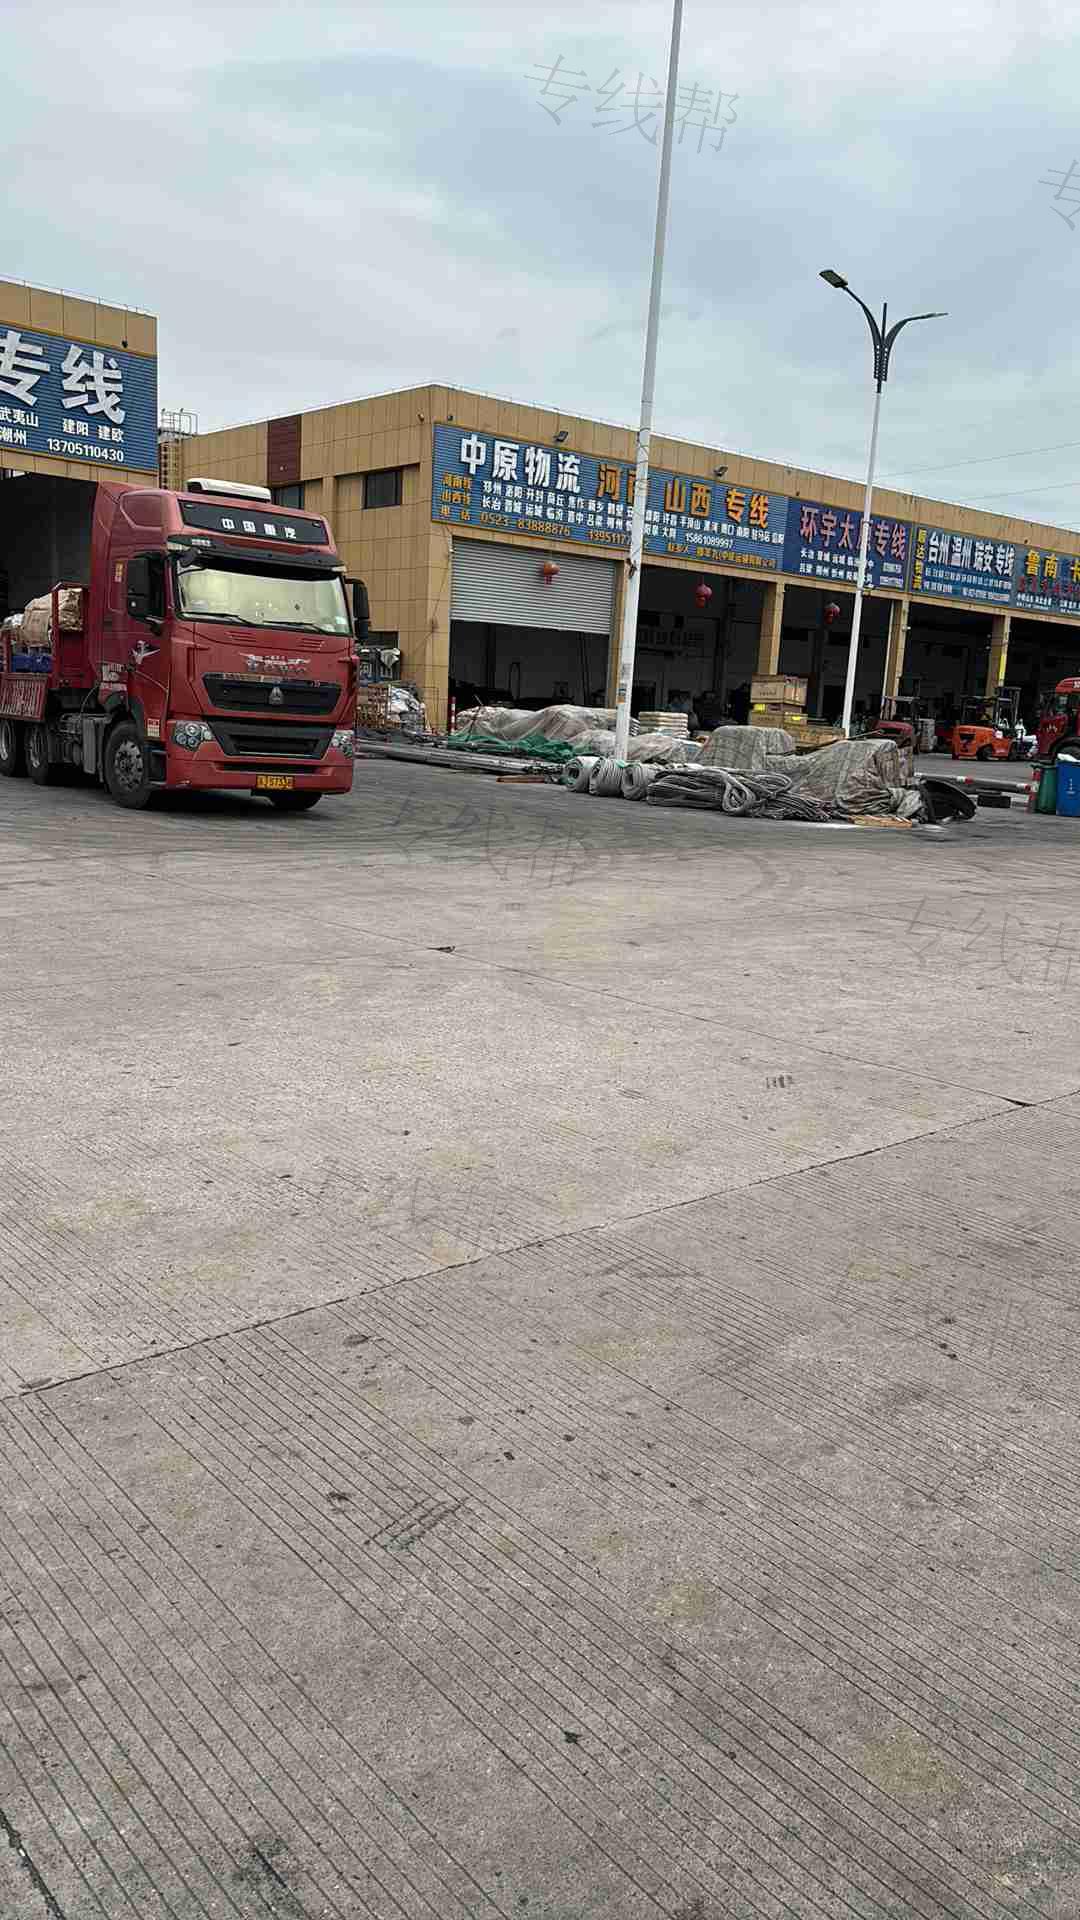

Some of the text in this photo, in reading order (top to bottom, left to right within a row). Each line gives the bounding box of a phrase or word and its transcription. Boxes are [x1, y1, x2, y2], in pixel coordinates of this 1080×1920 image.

[0, 330, 125, 425] 专线
[47, 438, 124, 462] 13705110430
[62, 418, 89, 436] 建阳
[460, 434, 769, 529] 中原物流 河 山西 专线
